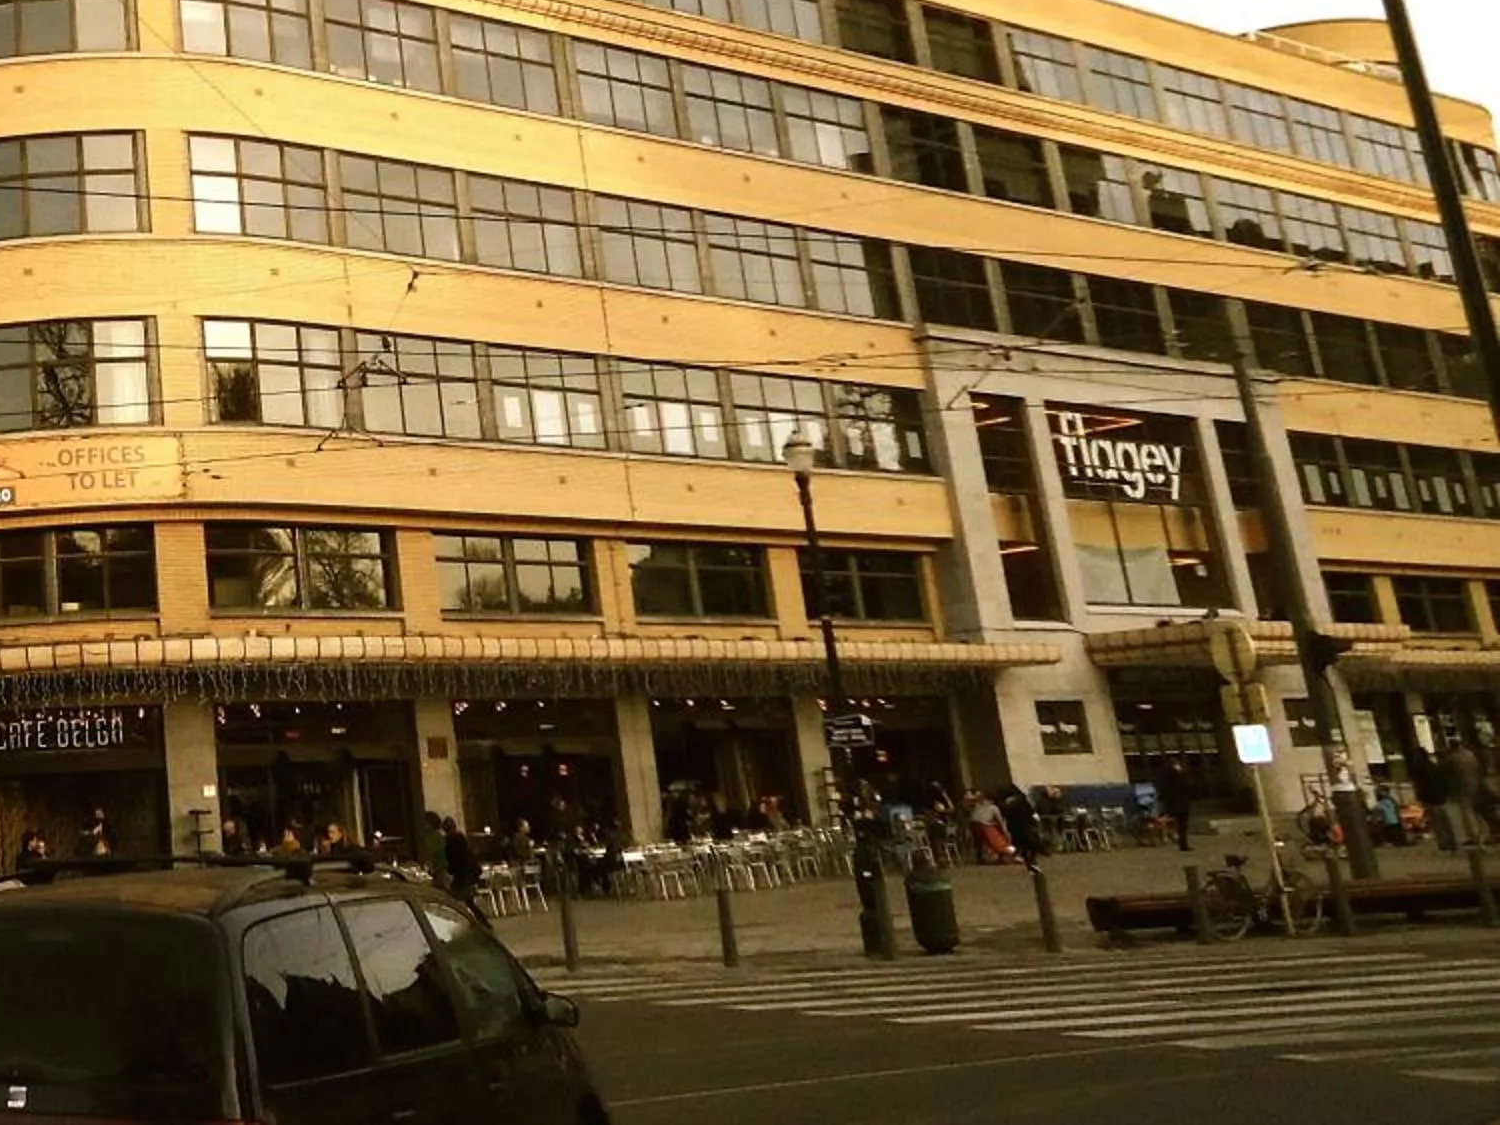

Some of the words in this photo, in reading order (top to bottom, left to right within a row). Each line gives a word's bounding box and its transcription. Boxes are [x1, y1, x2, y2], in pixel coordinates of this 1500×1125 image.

[57, 445, 145, 467] OFFICES
[1059, 412, 1182, 500] flagey
[67, 472, 96, 491] TO
[101, 469, 139, 489] LET
[56, 714, 123, 748] BELGA
